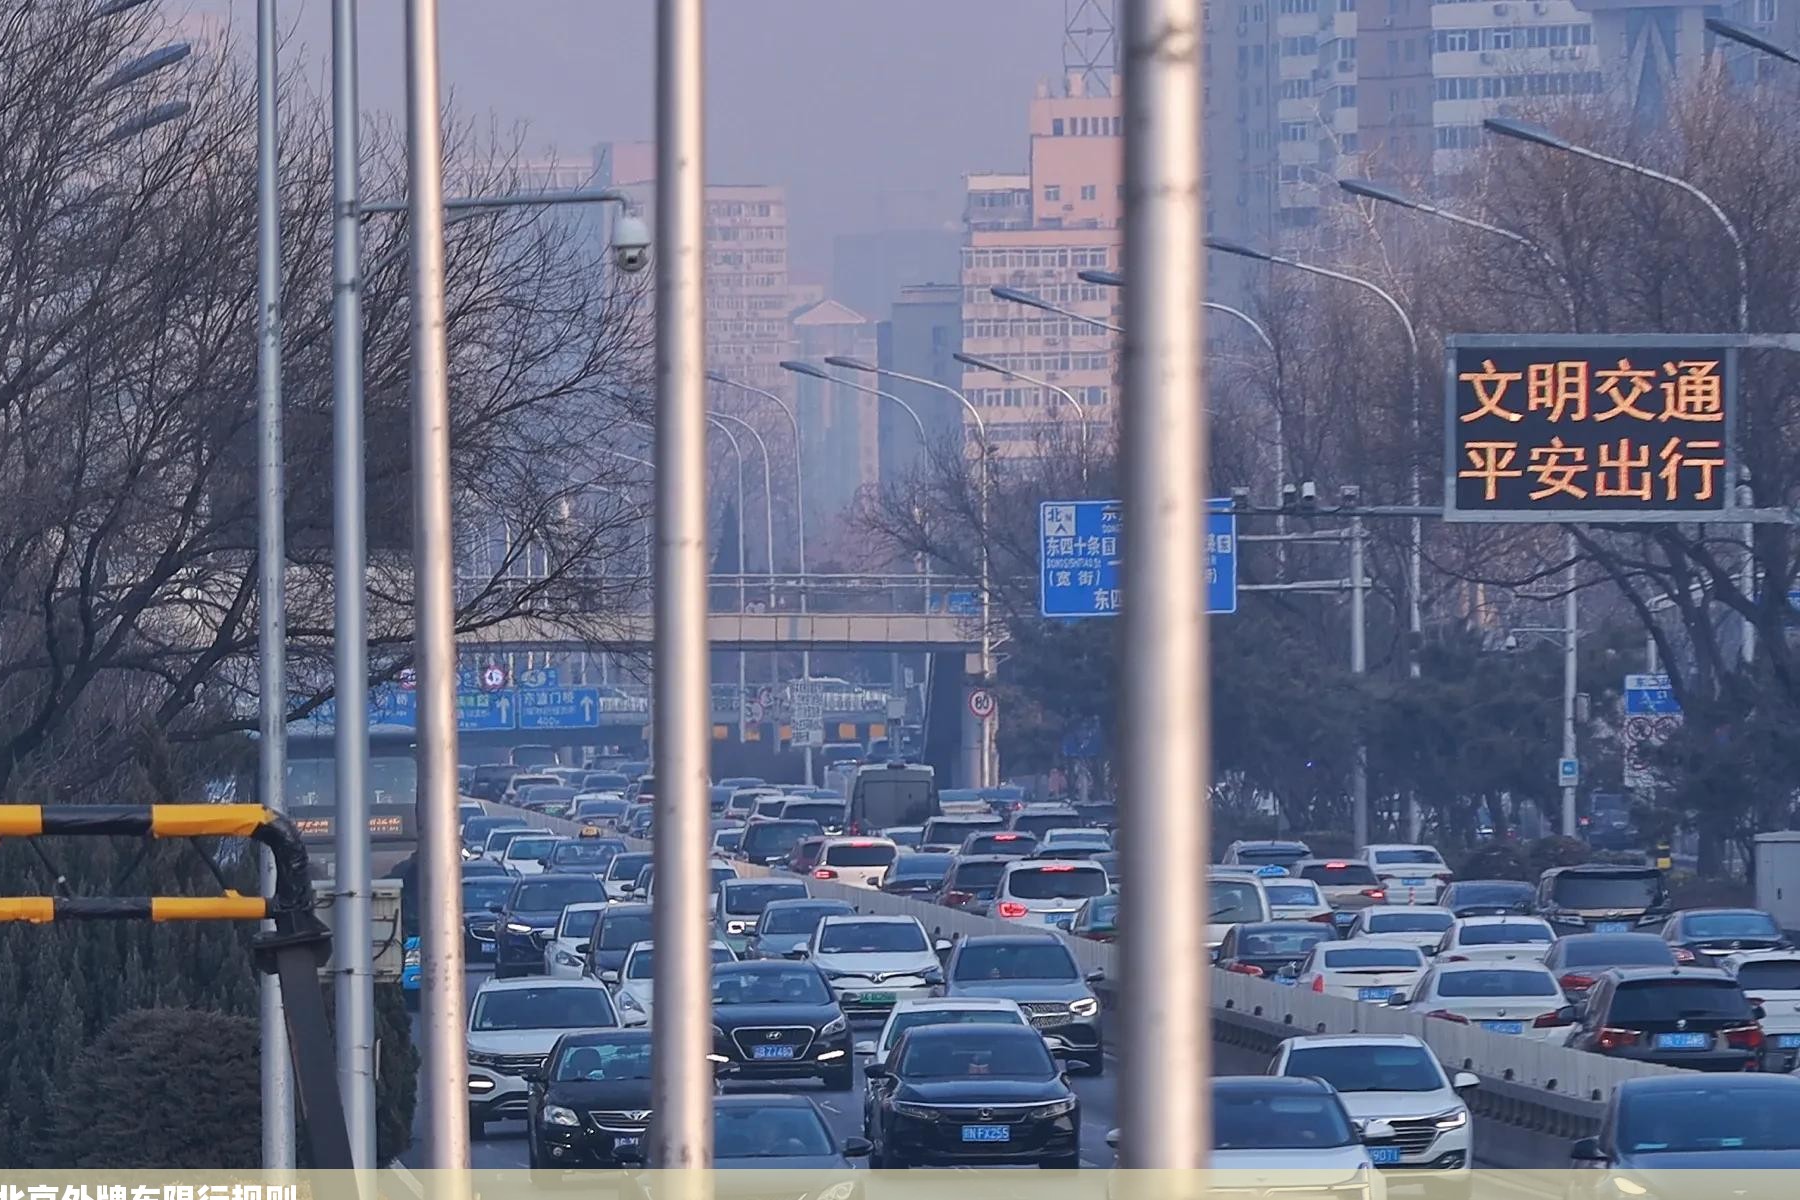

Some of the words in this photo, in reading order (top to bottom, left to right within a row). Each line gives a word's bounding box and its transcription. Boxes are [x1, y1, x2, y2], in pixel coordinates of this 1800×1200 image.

[1458, 357, 1725, 423] 文明交通
[1458, 435, 1725, 501] 平安出行
[1046, 535, 1100, 557] 东四十条
[975, 695, 989, 710] 80
